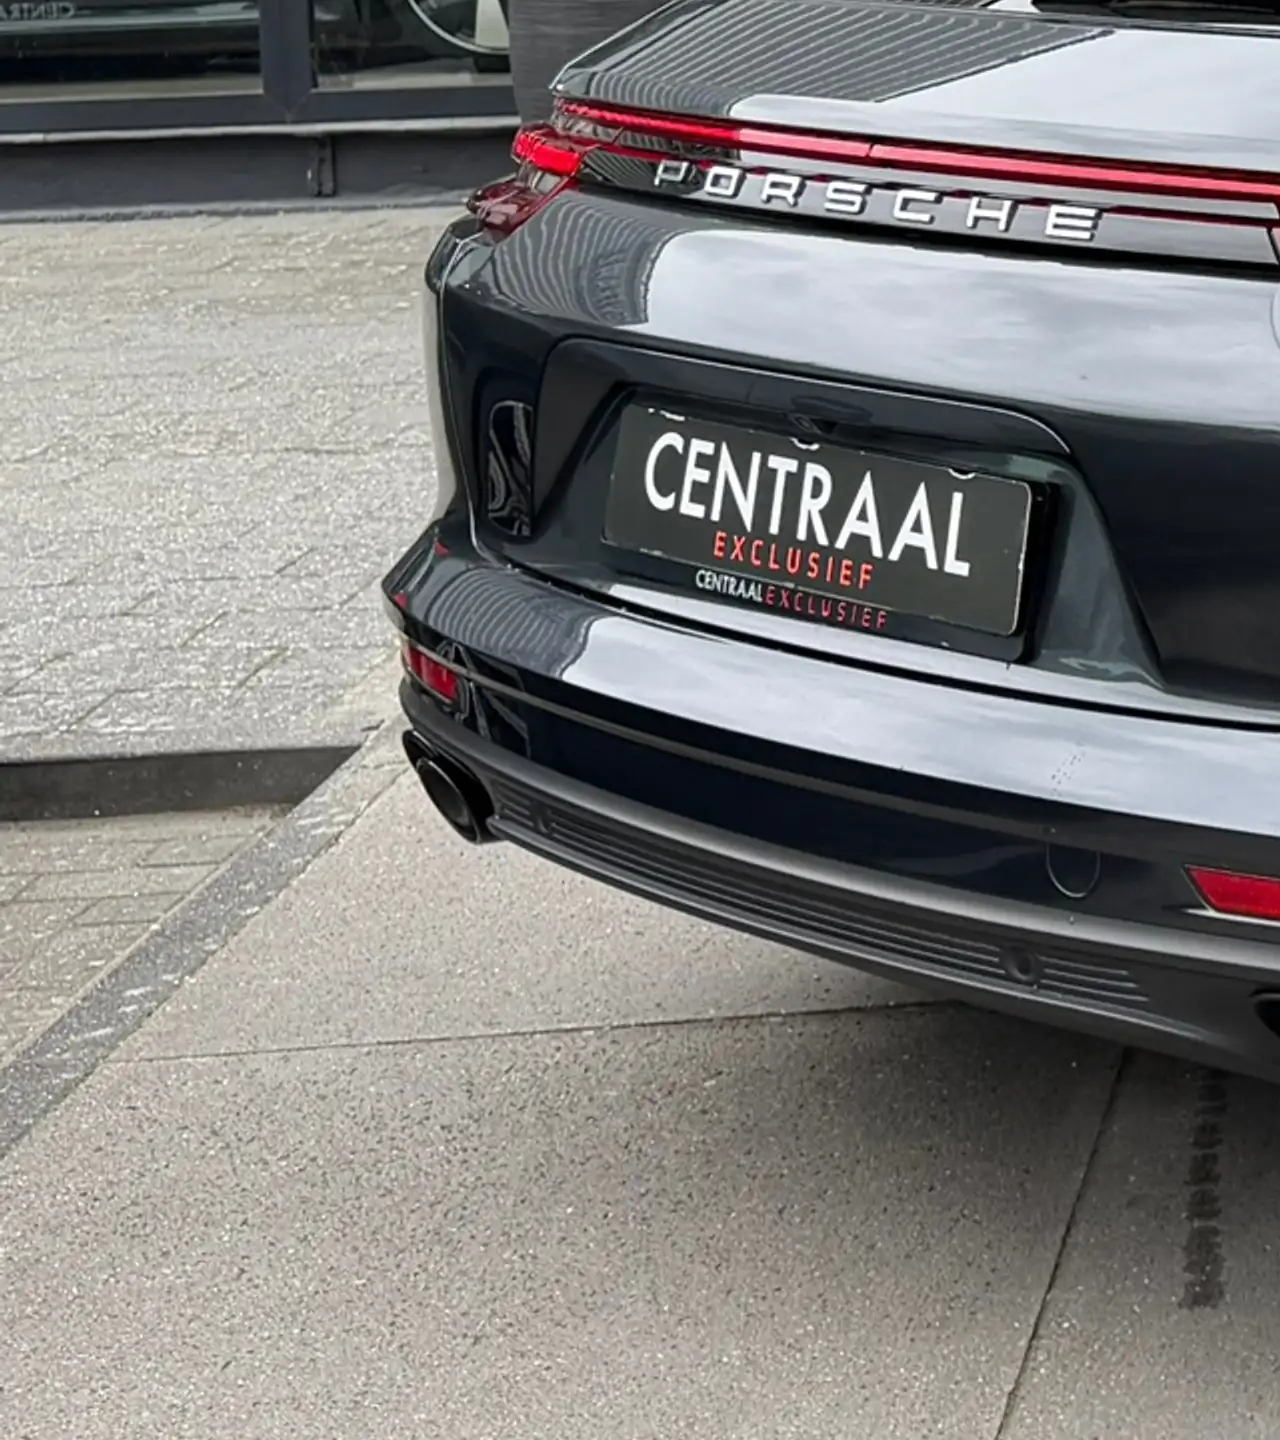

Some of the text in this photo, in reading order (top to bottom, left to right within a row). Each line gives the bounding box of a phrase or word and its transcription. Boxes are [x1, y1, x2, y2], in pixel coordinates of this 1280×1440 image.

[654, 158, 1100, 241] PORSCHE
[644, 431, 970, 577] CENTRAAL
[713, 530, 876, 591] EXCLUSIEF
